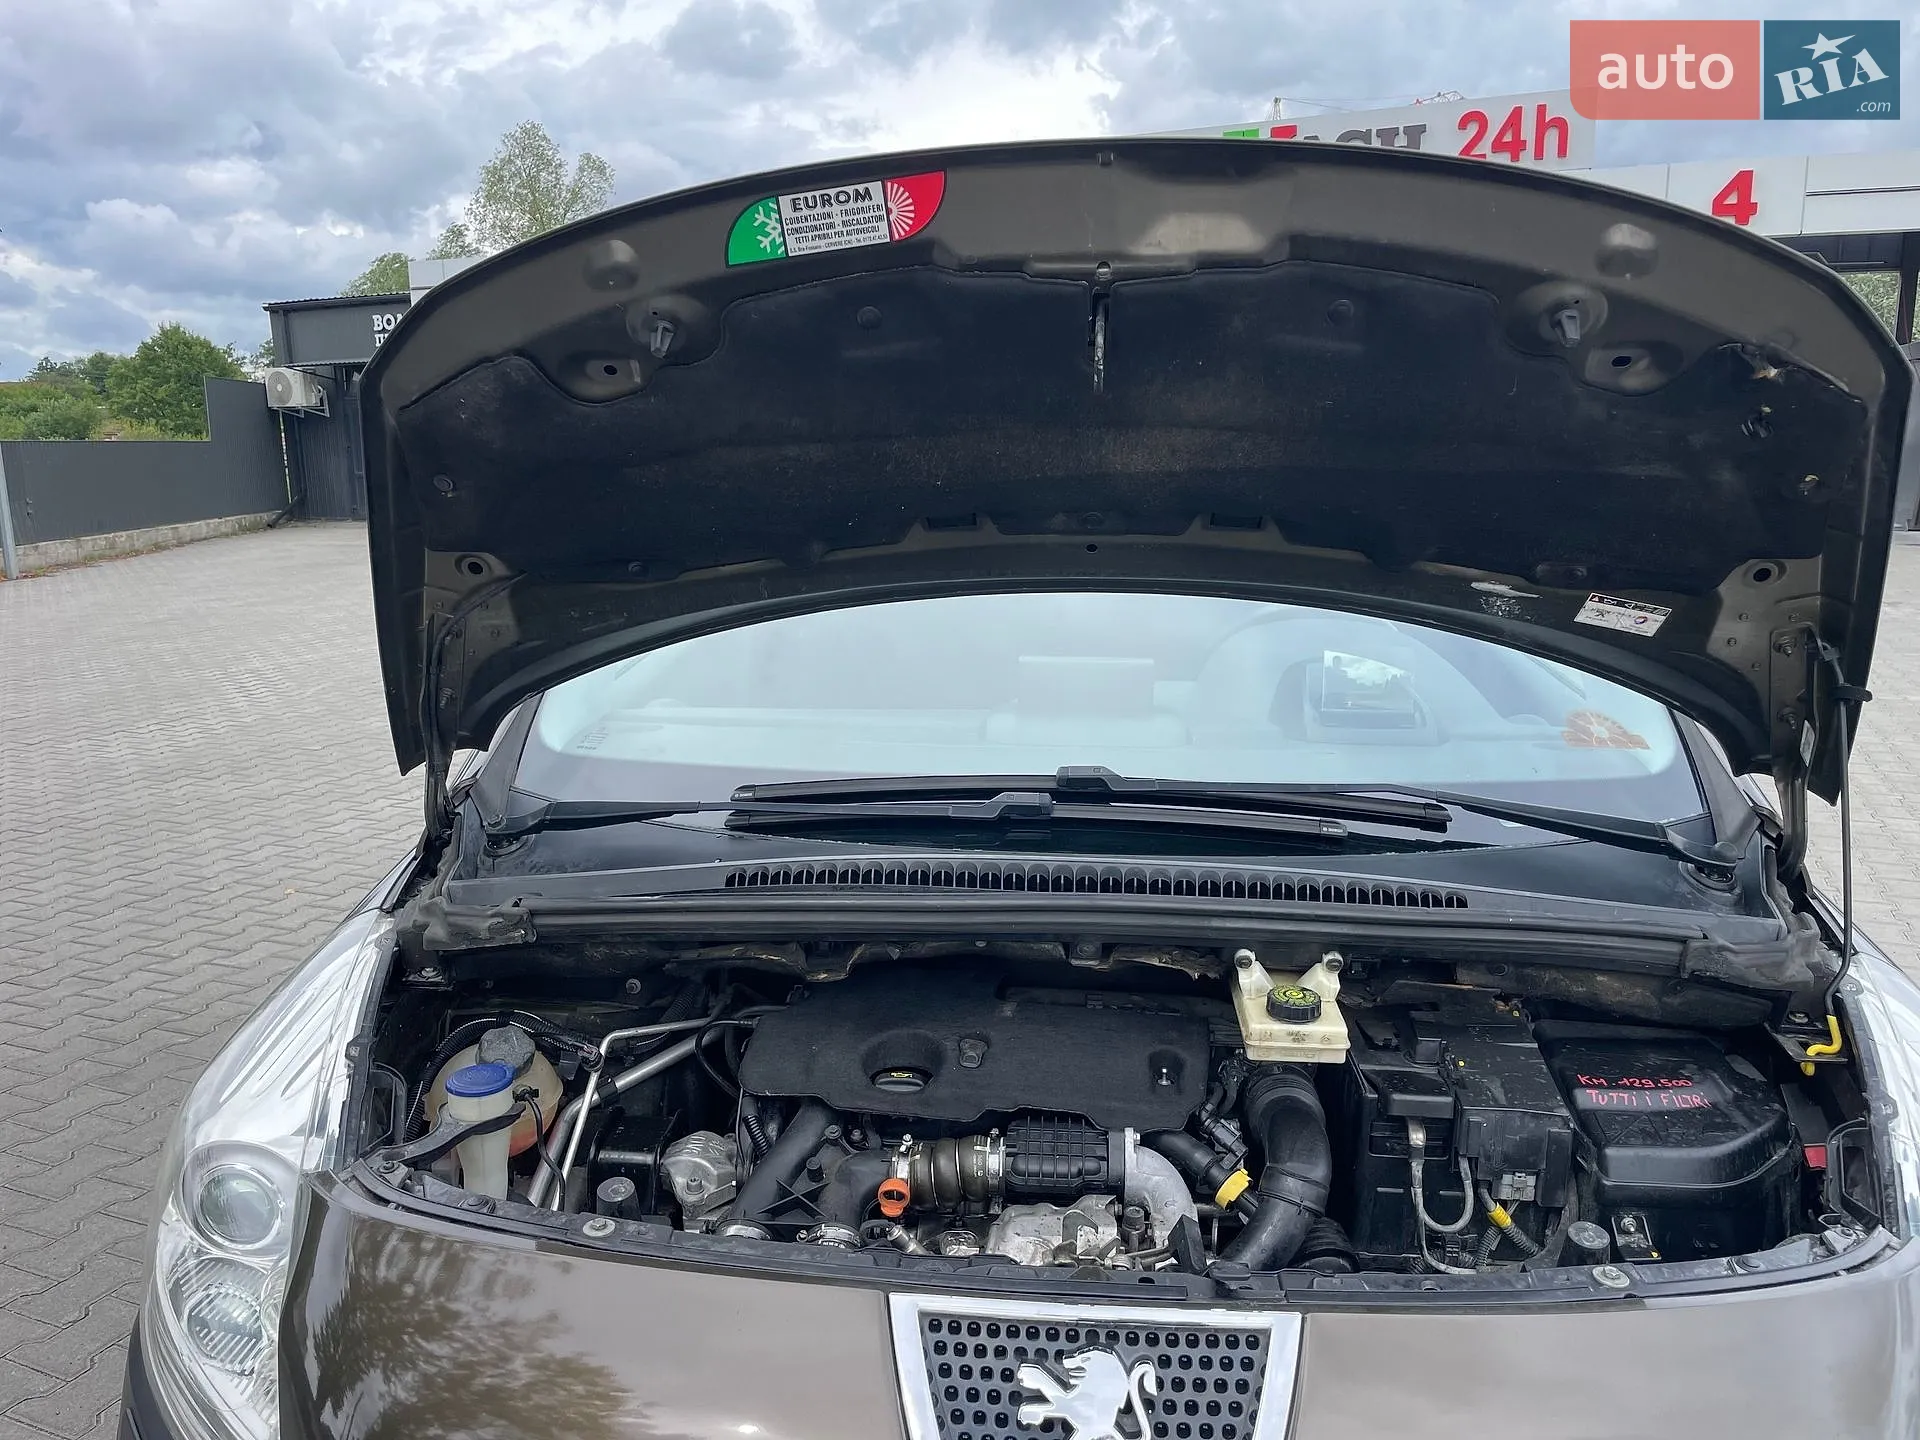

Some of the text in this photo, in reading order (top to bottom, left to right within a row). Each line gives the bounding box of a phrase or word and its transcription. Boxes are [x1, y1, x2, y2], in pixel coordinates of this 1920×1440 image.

[1456, 104, 1569, 162] 24h
[790, 187, 872, 212] EUROM
[1711, 169, 1759, 226] 4
[784, 204, 883, 226] COIBENTAZIONI FRIGORIFERI
[786, 215, 885, 236] CONDIZIONATORI RISCALDATORI
[794, 226, 879, 244] TETTI APRIBILI PER AUTOVEICOLI
